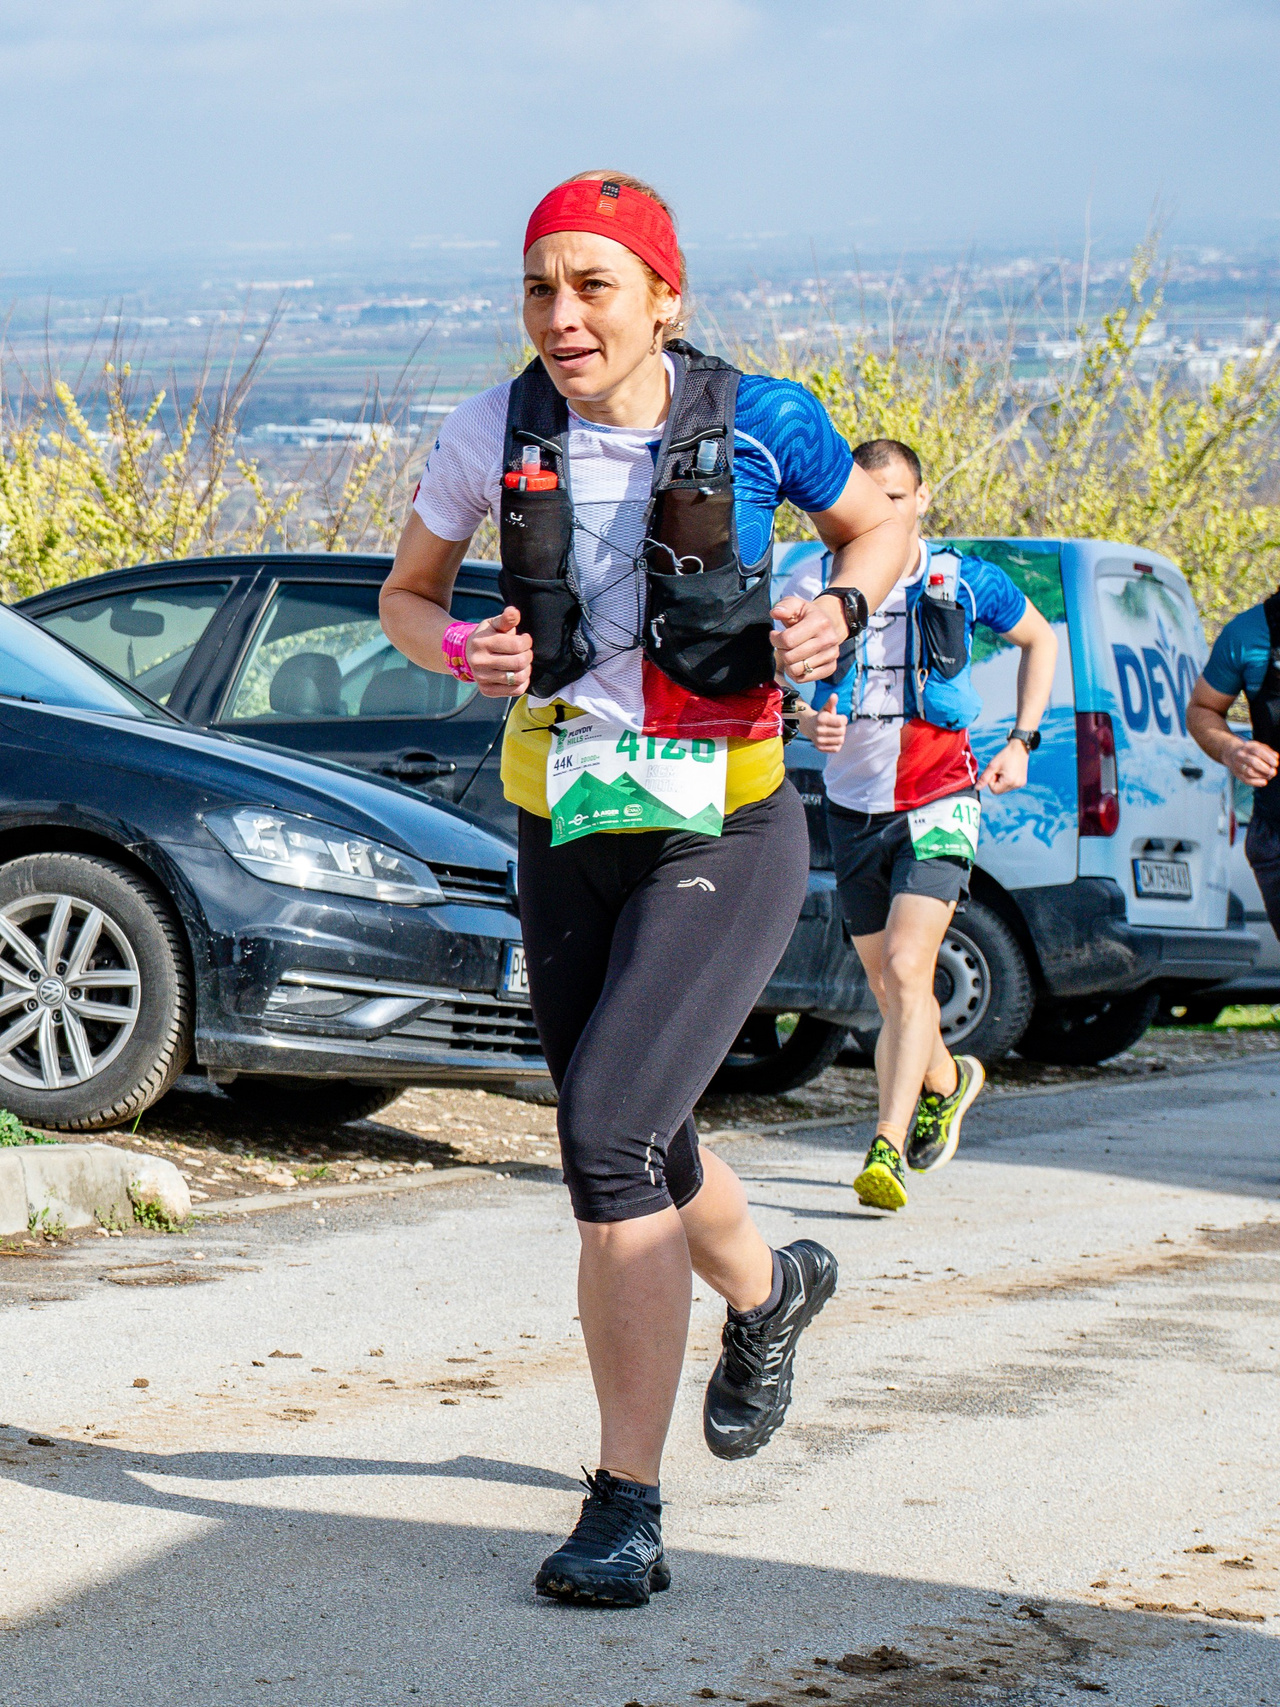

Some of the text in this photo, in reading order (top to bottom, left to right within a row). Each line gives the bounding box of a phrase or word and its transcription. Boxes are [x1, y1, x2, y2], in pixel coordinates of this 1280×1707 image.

[568, 725, 593, 738] PLOVDIV
[567, 735, 584, 745] HILLS
[554, 754, 573, 771] 44K
